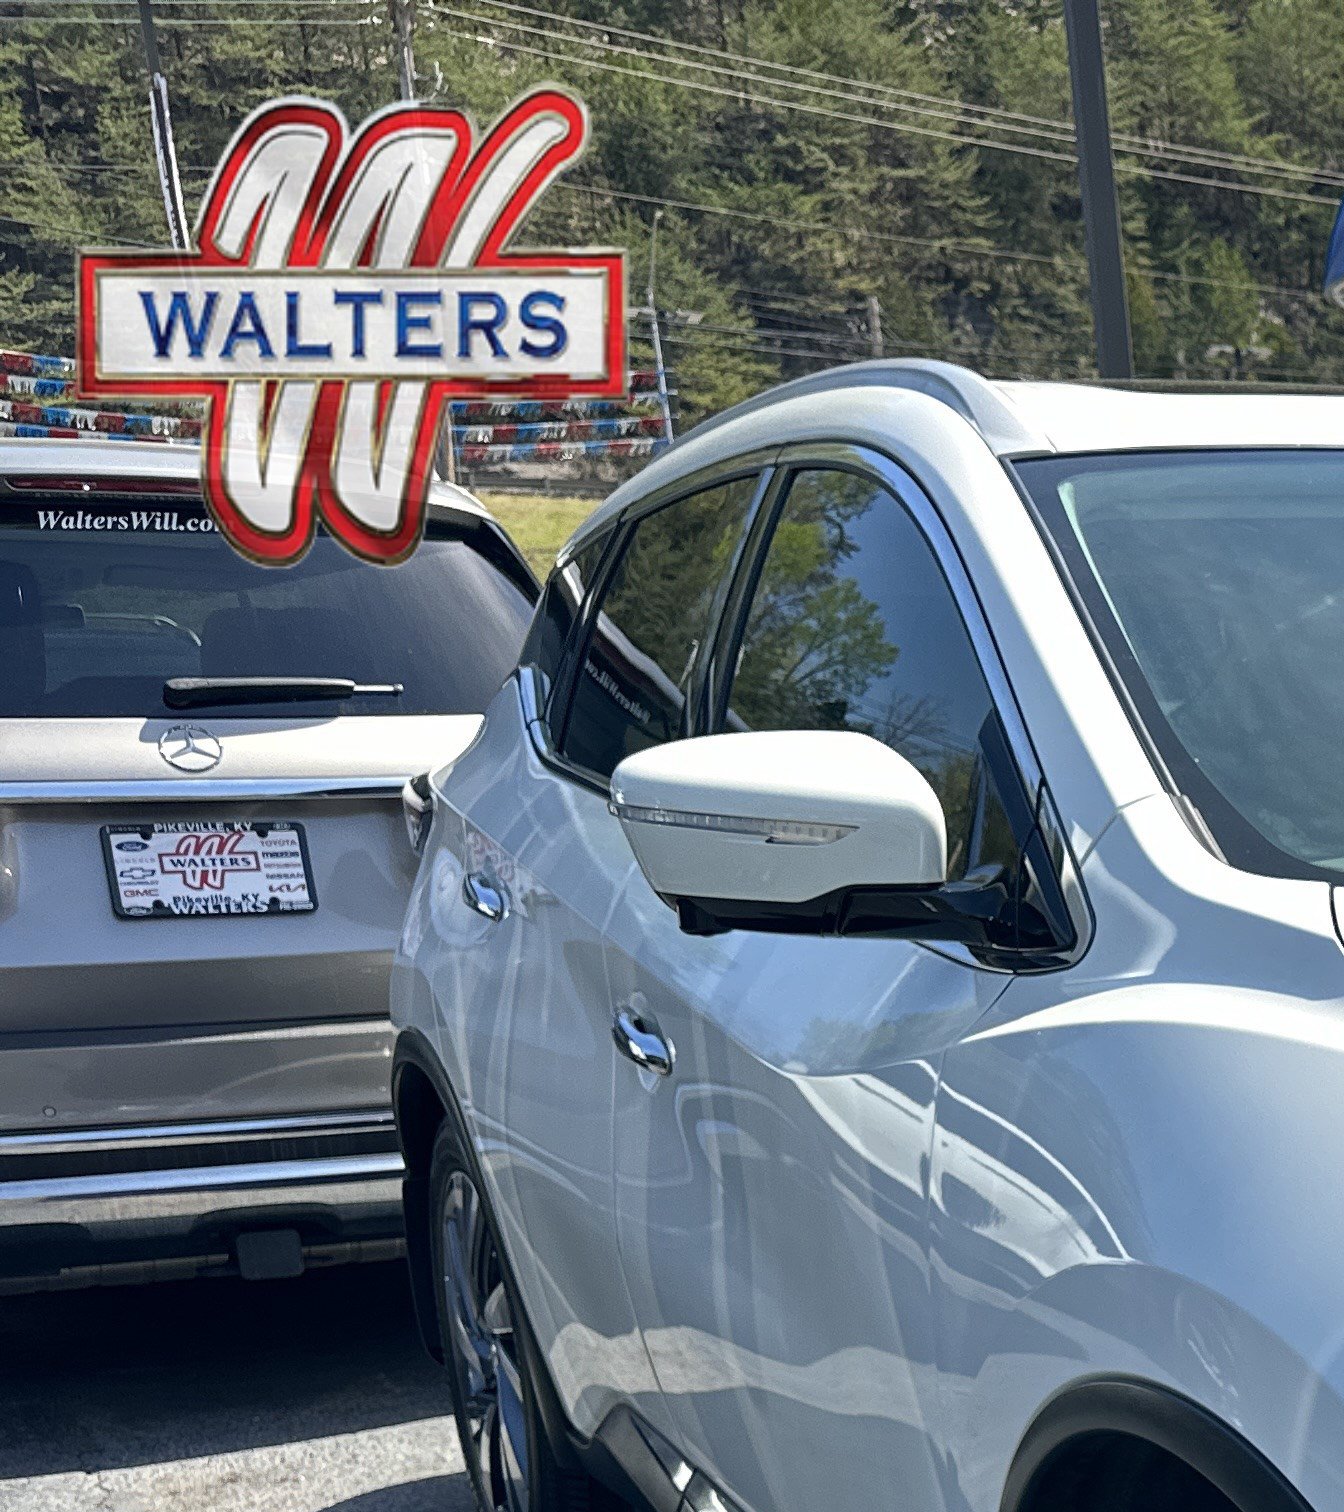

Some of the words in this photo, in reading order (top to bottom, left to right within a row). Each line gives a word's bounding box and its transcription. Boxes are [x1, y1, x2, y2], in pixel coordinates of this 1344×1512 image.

[154, 822, 230, 834] PIKEVILLE,
[233, 821, 253, 832] KY
[169, 857, 252, 868] WALTERS
[123, 888, 160, 897] GMC
[241, 893, 260, 902] KY
[168, 901, 270, 915] WALTERS
